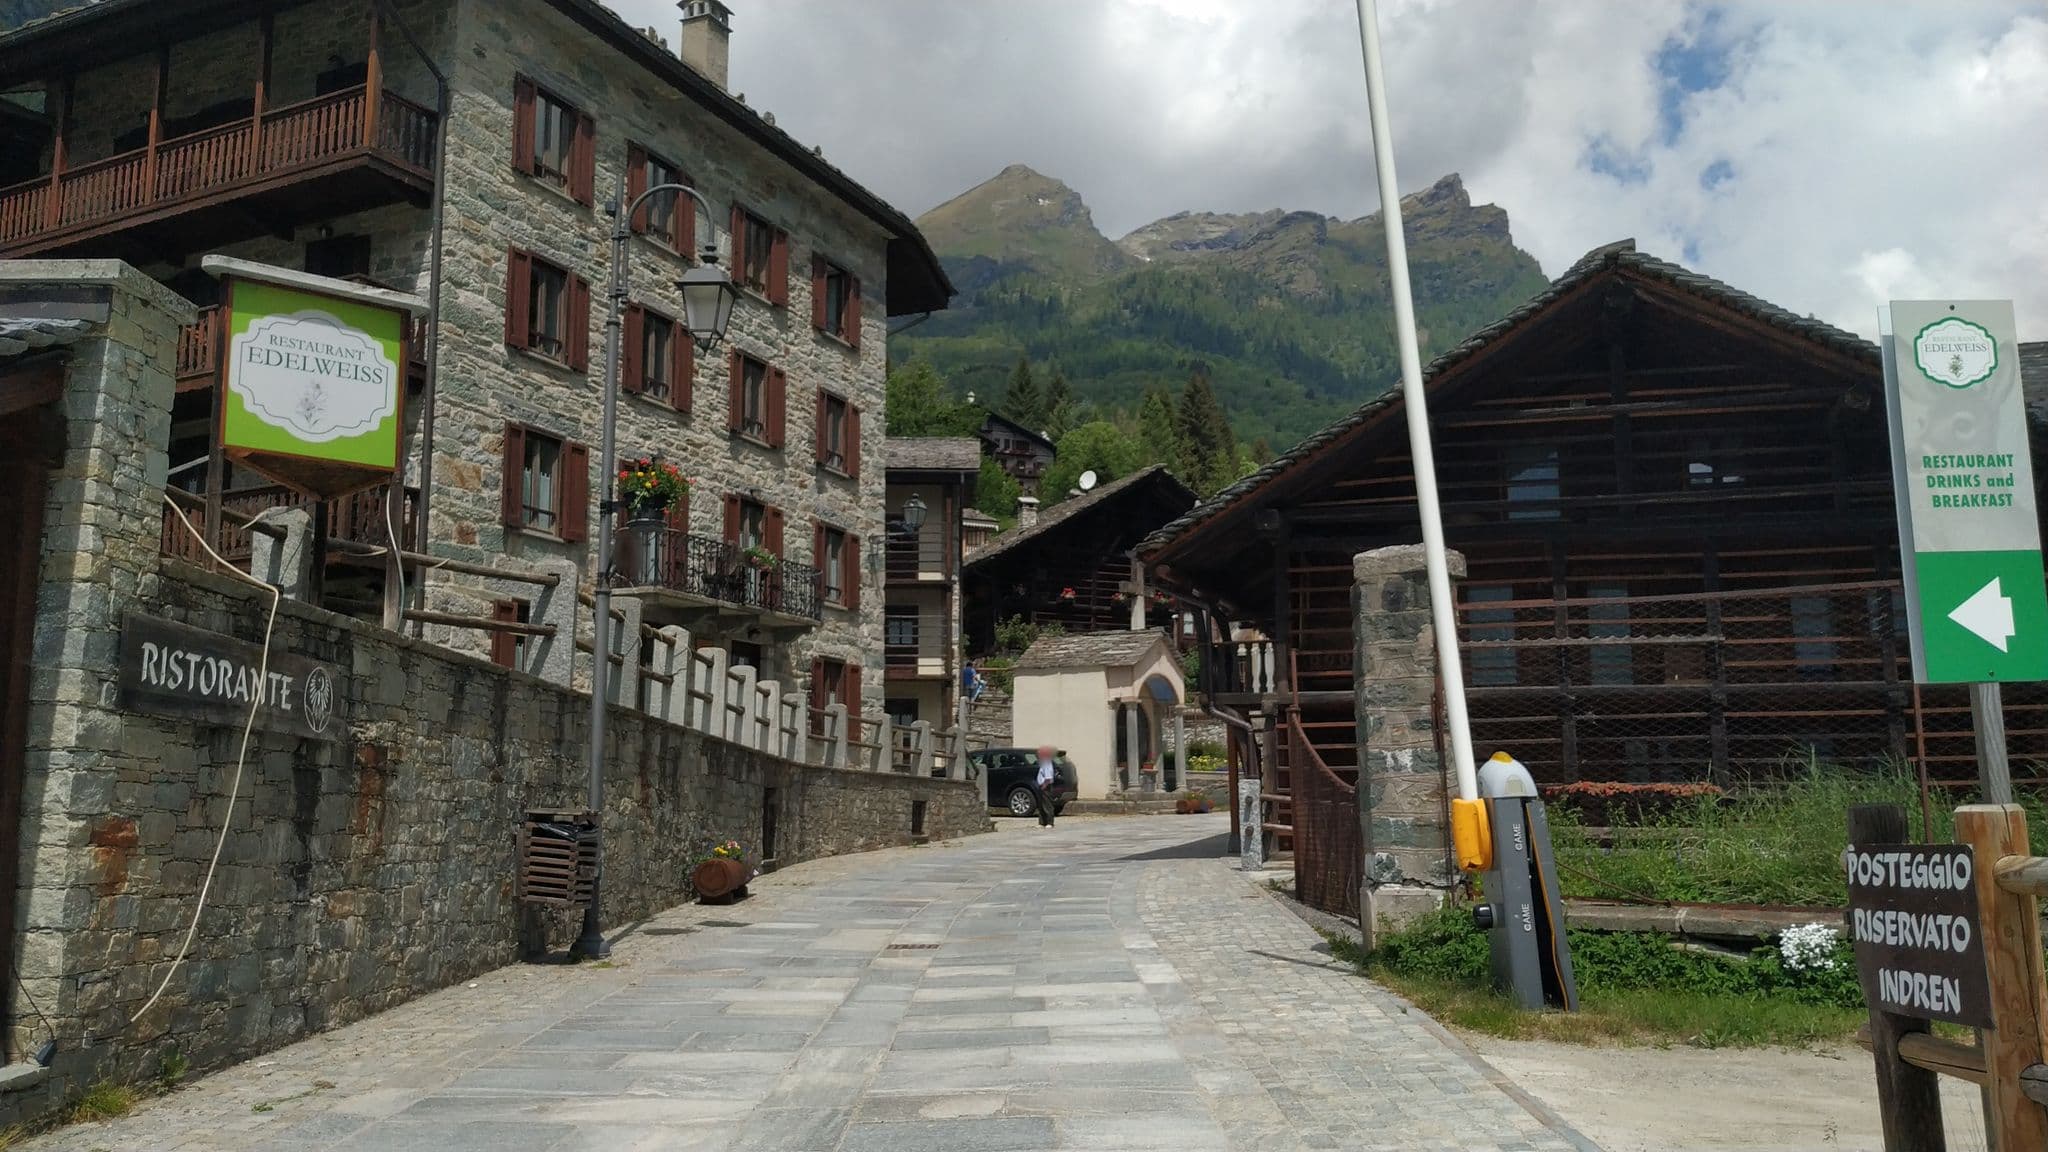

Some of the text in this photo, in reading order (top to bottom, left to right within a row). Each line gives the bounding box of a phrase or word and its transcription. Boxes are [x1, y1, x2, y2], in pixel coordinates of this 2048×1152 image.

[269, 334, 365, 361] RESTAURANT
[1924, 343, 1987, 353] EDELWEISS
[247, 346, 383, 385] EDELWEISS
[1922, 454, 2014, 469] RESTAURANT
[1926, 473, 2015, 488] DRINKS and
[1932, 493, 2013, 508] BREAKFAST
[141, 642, 294, 710] RISTORANTE
[1847, 852, 1971, 890] POSTEGGIO
[1854, 908, 1971, 953] RISERVATO
[1879, 967, 1961, 1015] INDREN
